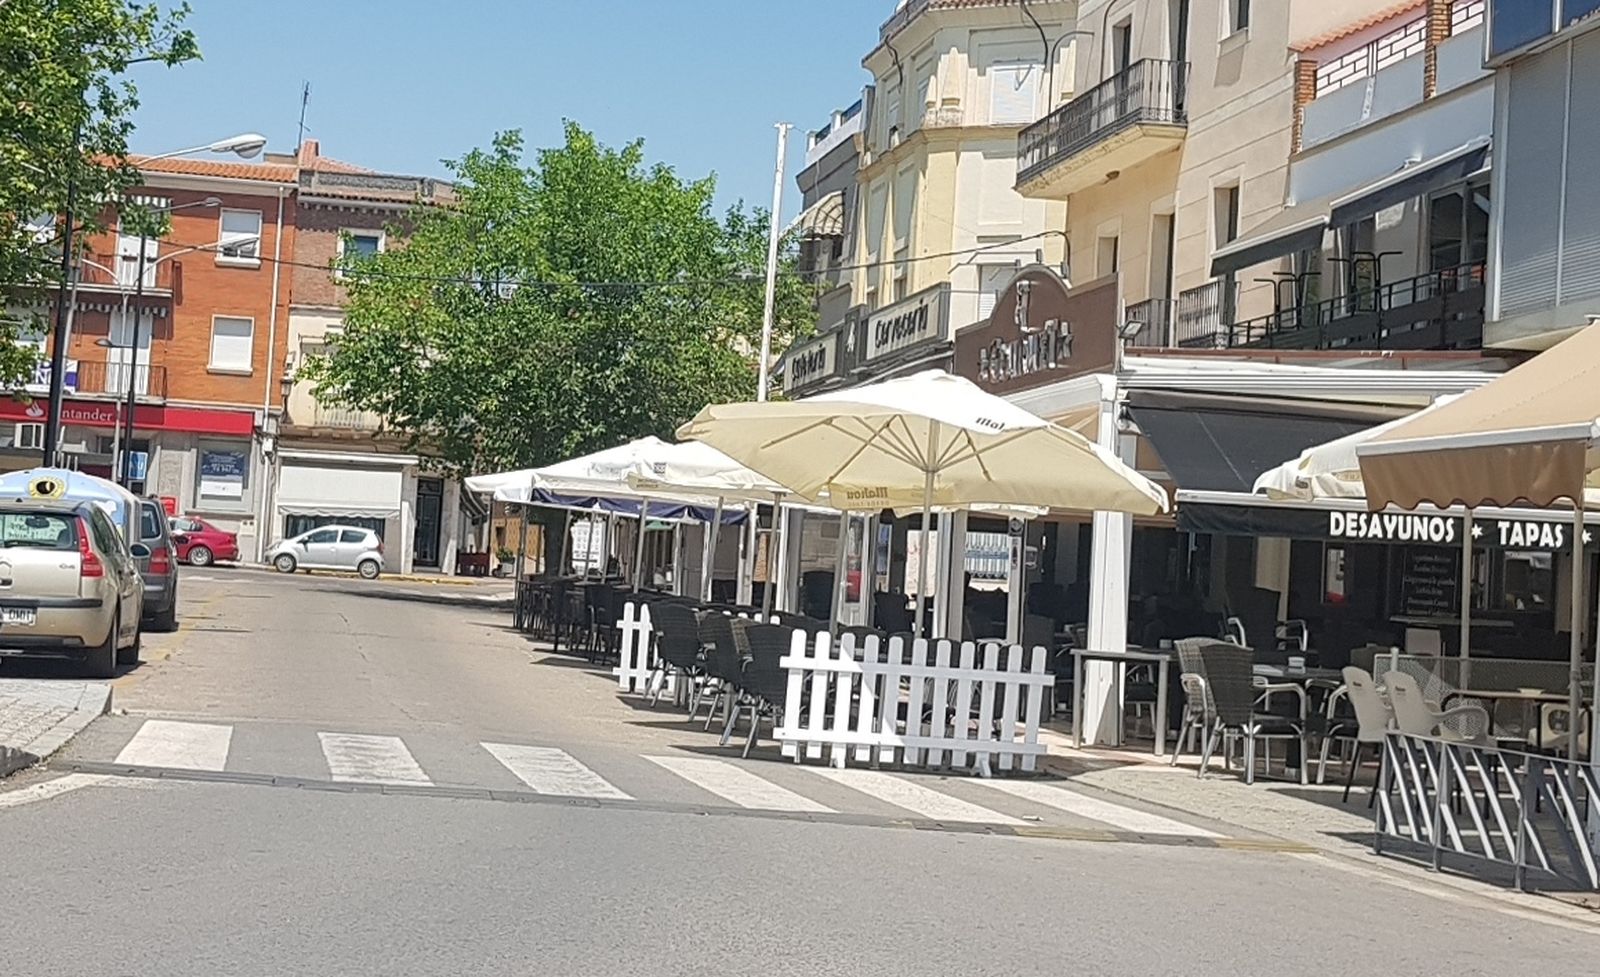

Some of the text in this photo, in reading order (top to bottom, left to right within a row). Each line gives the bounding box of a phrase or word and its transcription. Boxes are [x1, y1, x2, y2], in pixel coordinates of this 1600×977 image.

[61, 407, 113, 422] ntander
[1329, 511, 1563, 548] DESAYUNOS TAPAS
